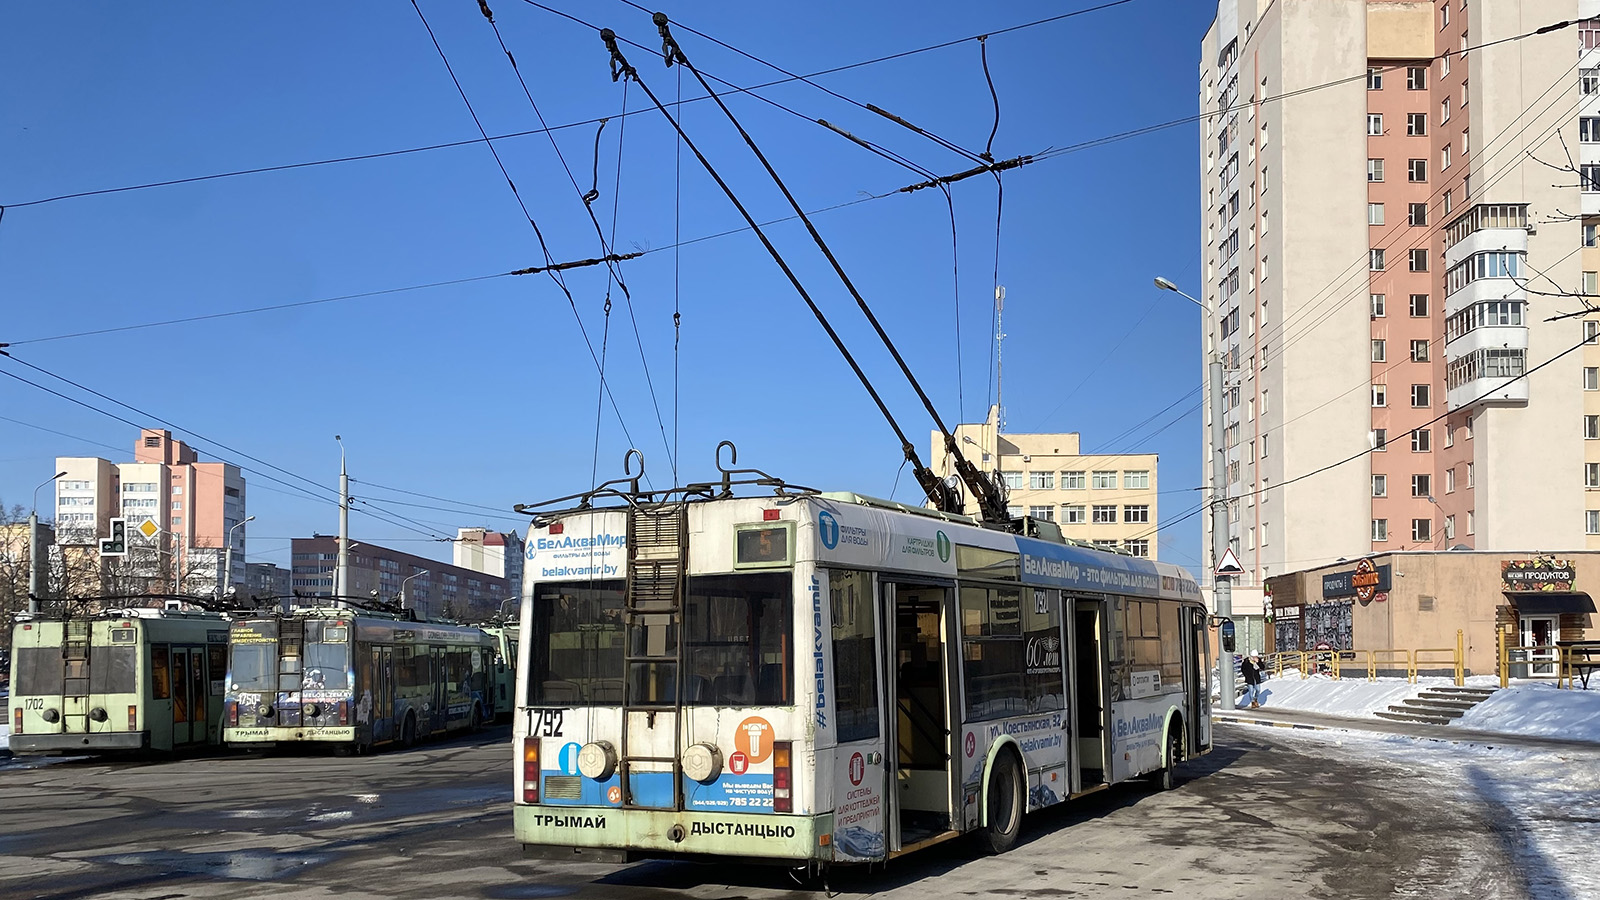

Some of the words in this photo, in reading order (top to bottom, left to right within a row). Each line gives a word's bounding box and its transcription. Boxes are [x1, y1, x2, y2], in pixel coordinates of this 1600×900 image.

[840, 525, 867, 536] ФИЛЬТРЫ
[537, 534, 626, 550] БелАкваМир
[760, 530, 771, 556] 5
[853, 537, 868, 546] ВОДЫ
[907, 537, 934, 548] КАРТРИДЖИ
[542, 564, 618, 577] belakvamir.by
[1024, 554, 1080, 582] БелАкваМир
[1087, 568, 1100, 582] это
[1100, 567, 1130, 589] фильтры
[1524, 572, 1570, 580] ПРОДУКТОВ
[809, 575, 826, 729] #belakvamir
[24, 698, 44, 710] 1702
[527, 709, 563, 737] 1792
[1053, 714, 1061, 727] 32
[1118, 713, 1163, 737] БелАкваМир
[847, 787, 872, 800] СИСТЕМЫ
[730, 798, 748, 806] 785
[748, 798, 761, 806] 22
[762, 798, 774, 806] 22
[838, 804, 850, 814] ДЛЯ
[850, 795, 880, 811] КОТТЕДЖЕЙ
[534, 815, 606, 829] ТРЫМАЙ
[843, 806, 880, 825] ПРЕДПРИЯТИЙ
[690, 822, 796, 838] ДЫСТАНЦЫЮ
